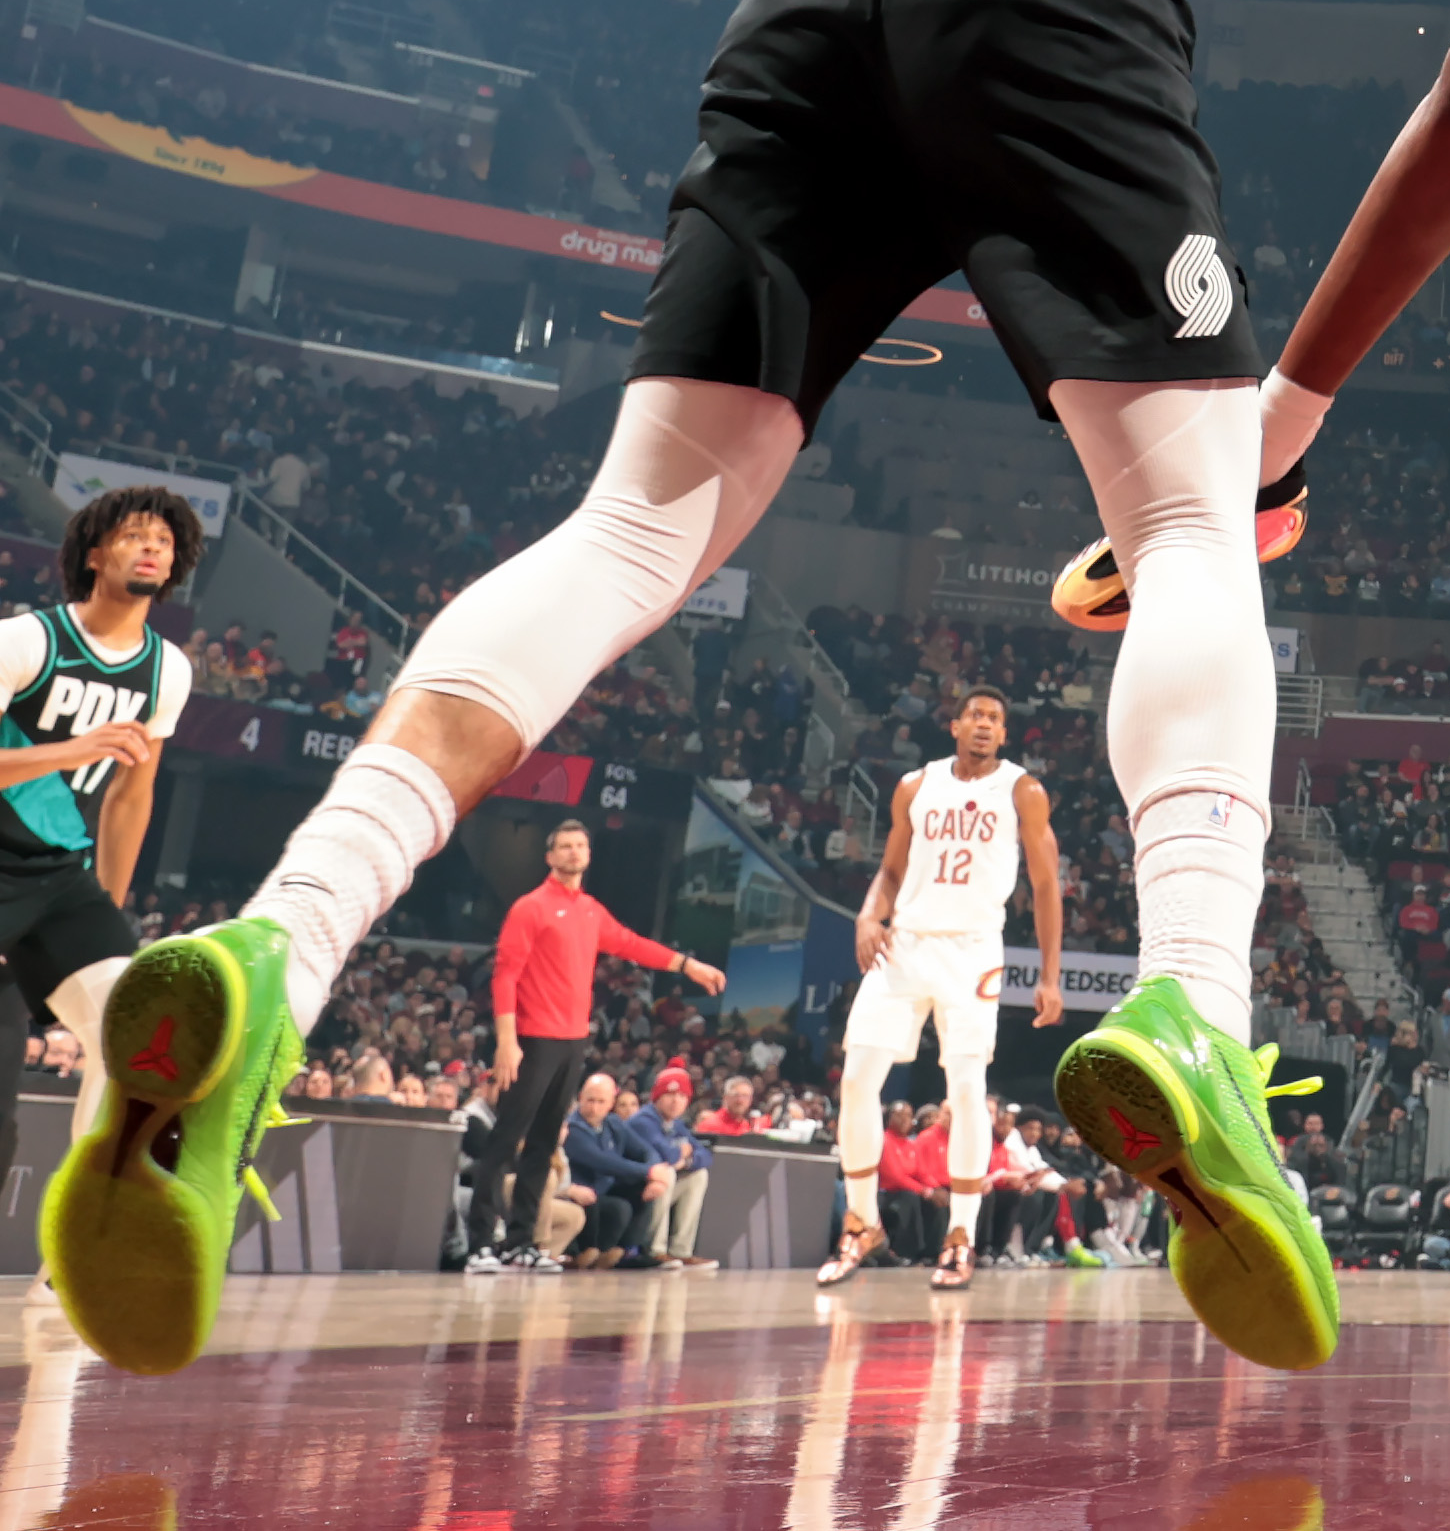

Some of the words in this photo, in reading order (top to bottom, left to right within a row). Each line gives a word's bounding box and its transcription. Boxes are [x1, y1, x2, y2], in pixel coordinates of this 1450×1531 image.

[560, 230, 617, 264] drug
[239, 716, 262, 752] 4
[600, 785, 628, 811] 64
[924, 808, 997, 844] CAVS
[933, 847, 973, 885] 12
